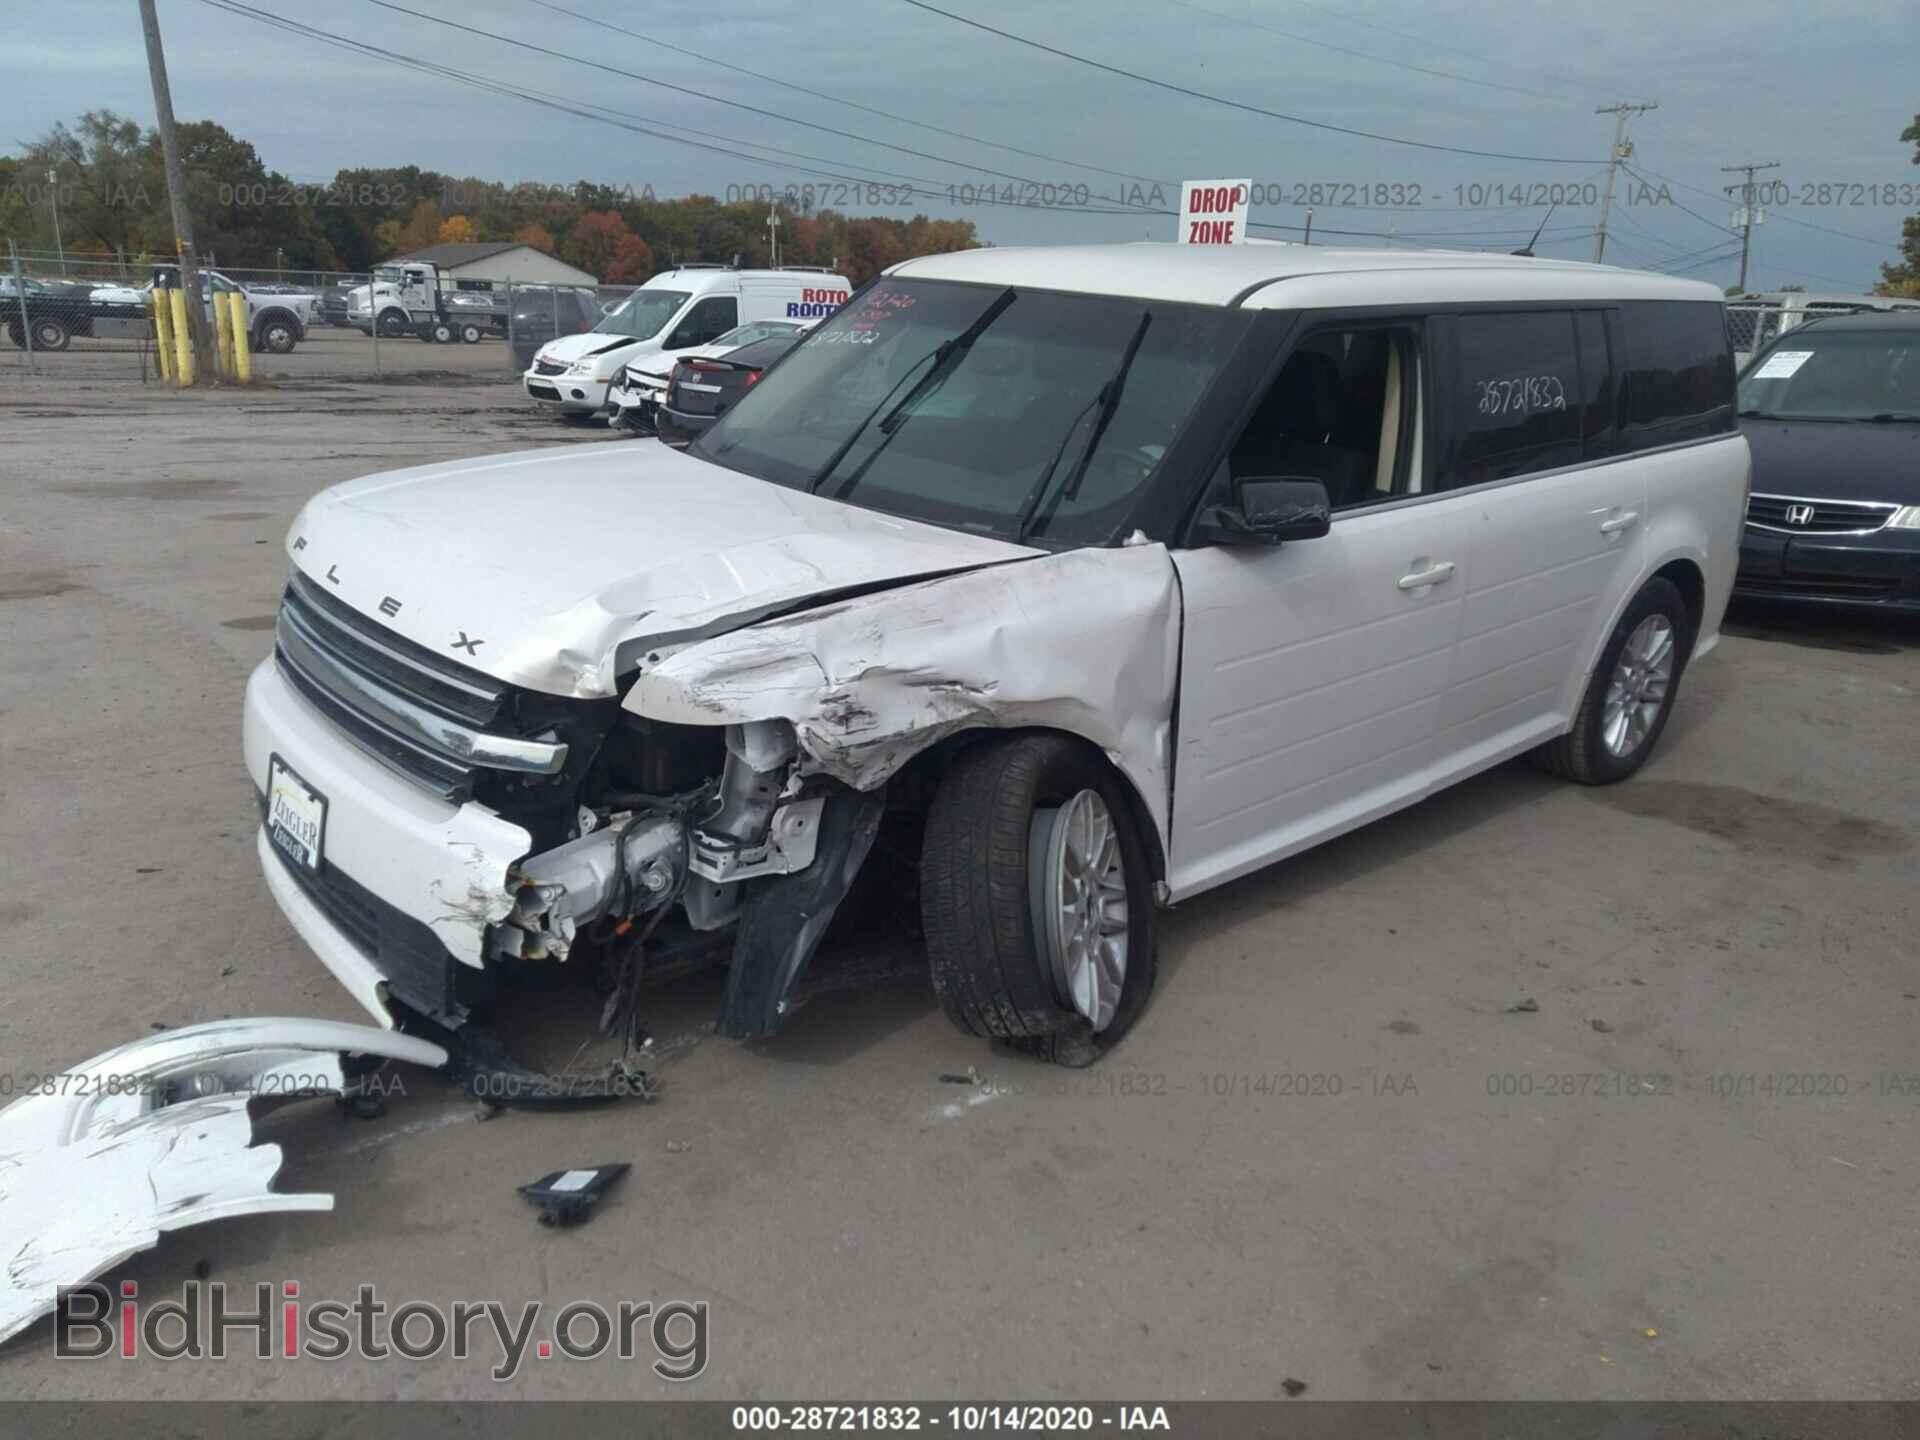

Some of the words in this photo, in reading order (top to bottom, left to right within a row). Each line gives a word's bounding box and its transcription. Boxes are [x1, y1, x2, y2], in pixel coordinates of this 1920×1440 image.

[1189, 187, 1242, 213] DROP
[1188, 220, 1235, 244] ZONE
[802, 288, 849, 304] ROTO
[786, 302, 842, 318] ROOT
[293, 535, 485, 657] FLEX
[274, 793, 318, 850] ZEIGLER
